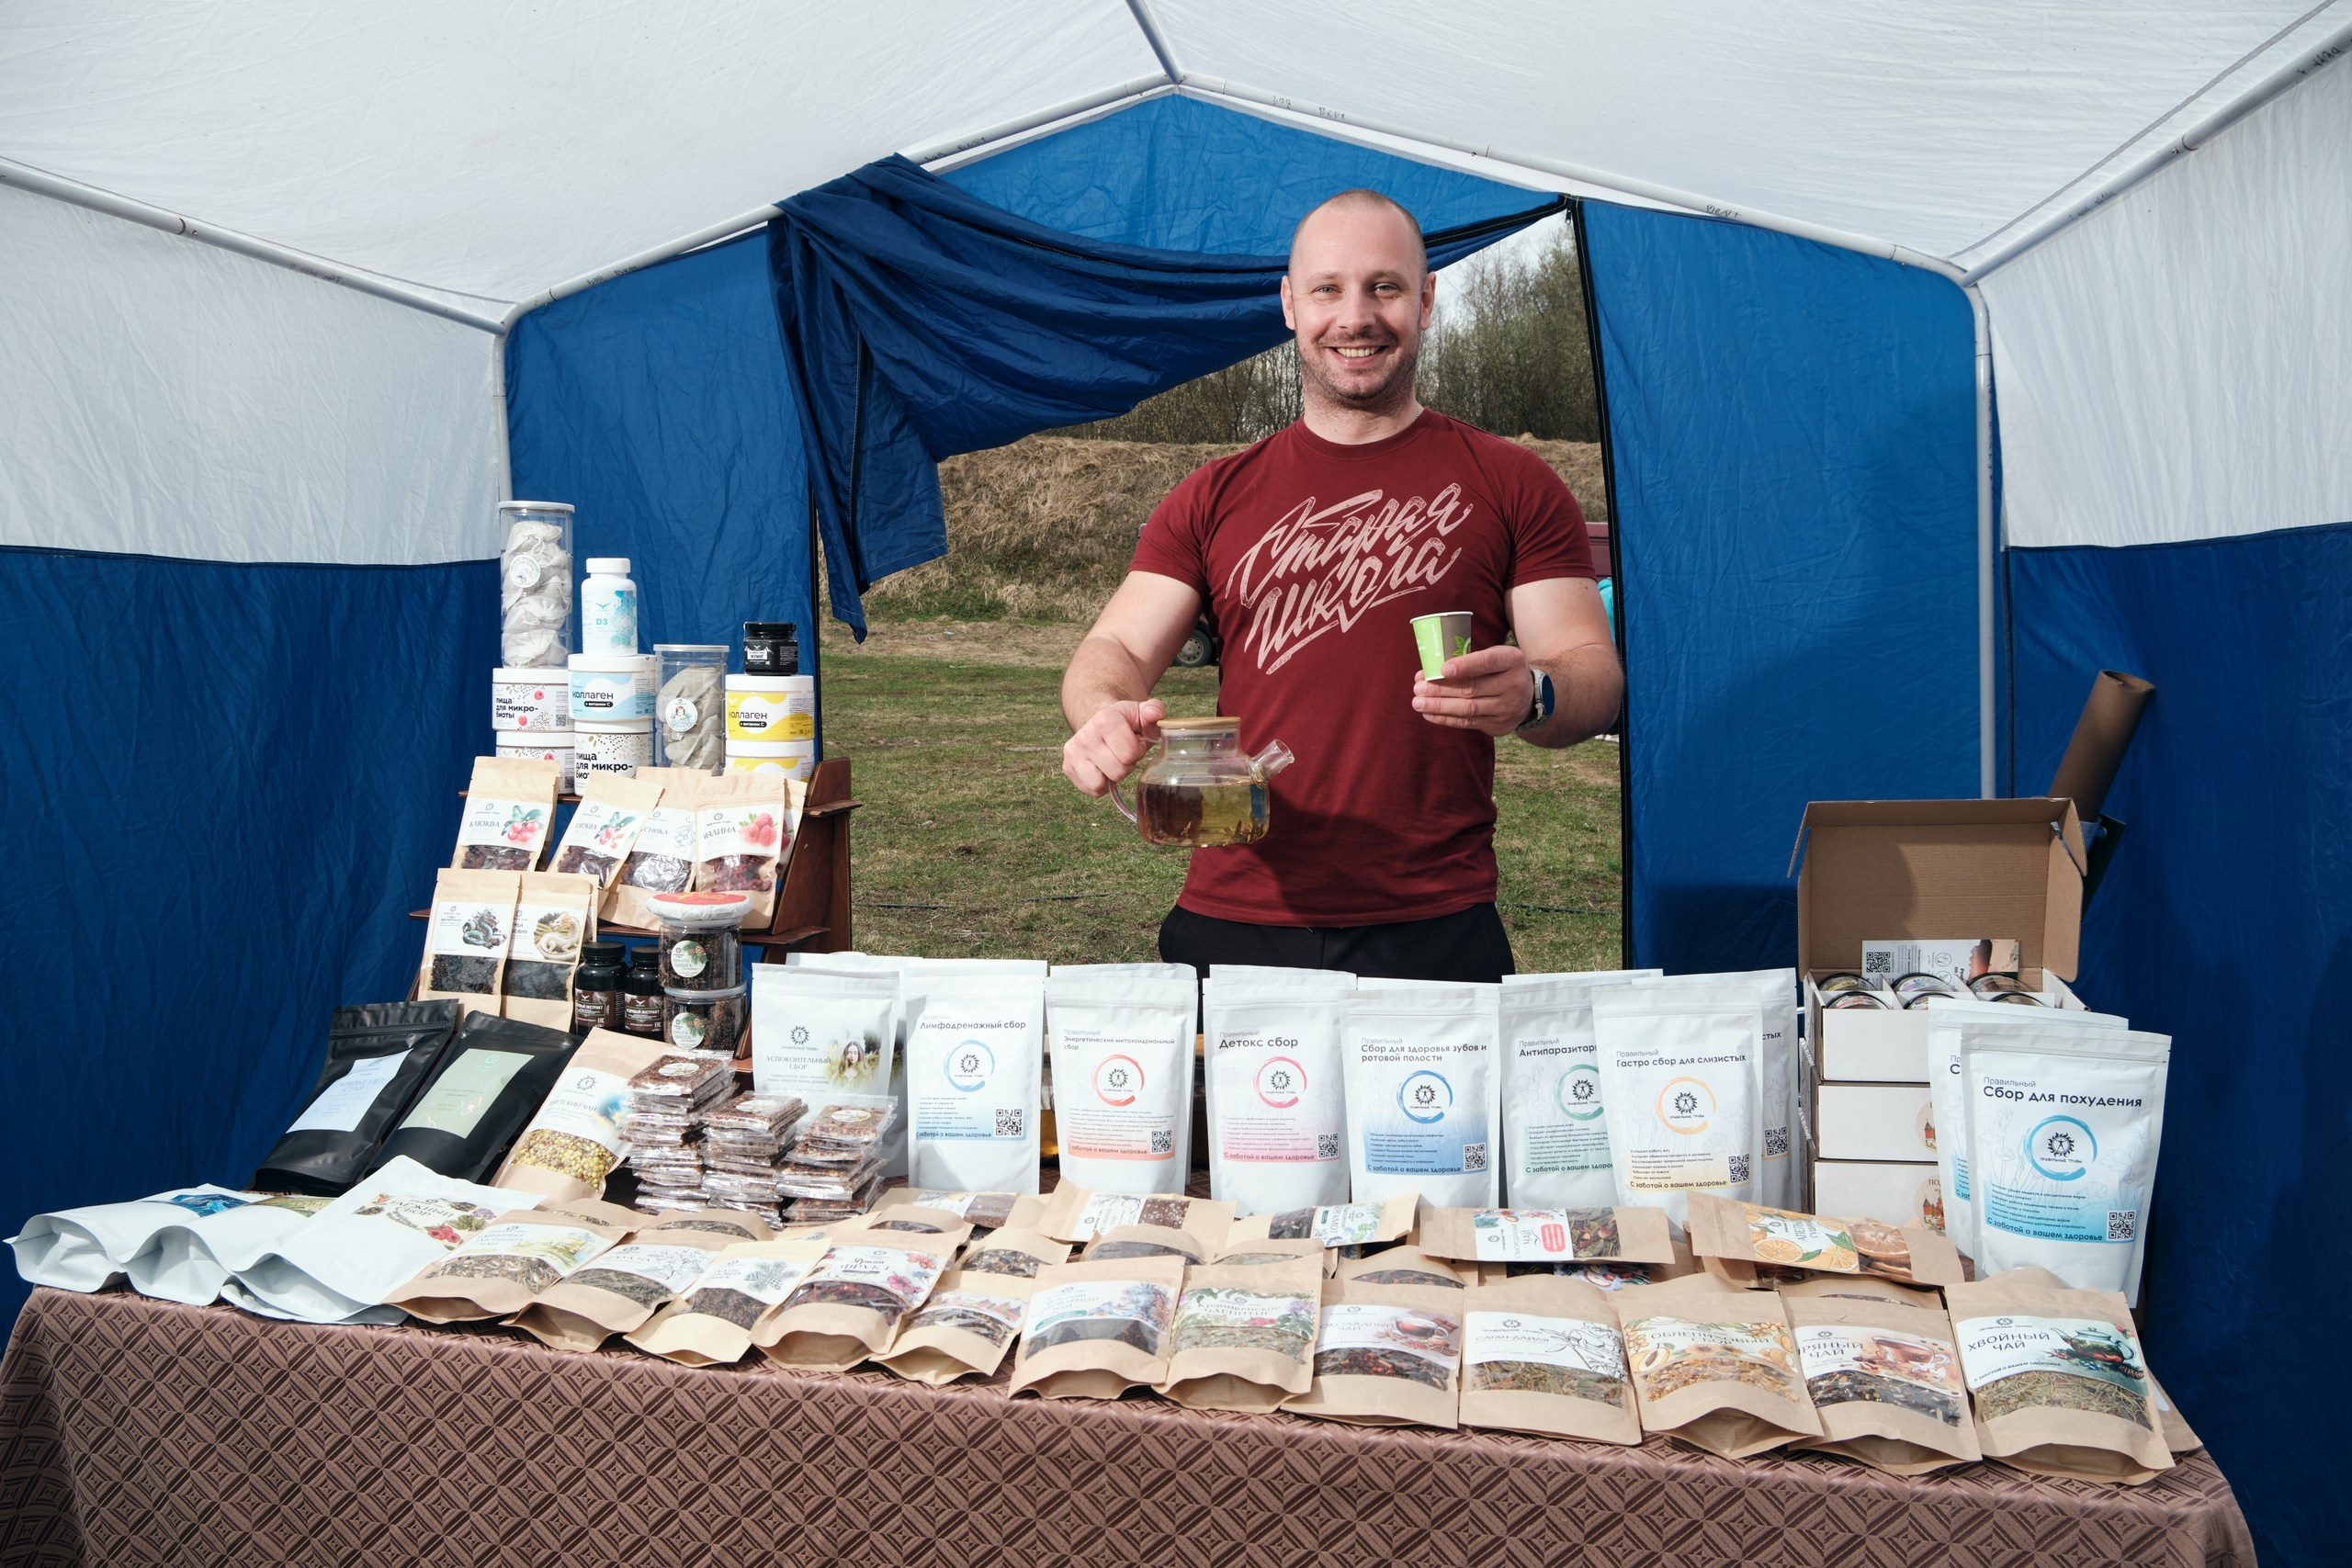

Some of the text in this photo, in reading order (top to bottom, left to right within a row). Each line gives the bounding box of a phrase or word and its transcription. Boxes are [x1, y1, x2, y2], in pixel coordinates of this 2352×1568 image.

[496, 697, 513, 705] пища
[571, 691, 614, 700] коллаген
[508, 705, 538, 714] микро-
[576, 752, 597, 761] пища
[576, 761, 633, 773] для микро-
[576, 769, 590, 780] био
[920, 1021, 1026, 1030] Лимфодренажный сбор
[1219, 1037, 1298, 1049] Детокс сбор
[1361, 1044, 1386, 1054] Сбор
[1408, 1045, 1450, 1054] здоровья
[1453, 1043, 1479, 1054] зубов
[1519, 1044, 1597, 1057] Антипаразитар
[1362, 1054, 1401, 1063] ротовой
[1616, 1055, 1747, 1068] Гастро сбор для слизистых
[1984, 1077, 2036, 1088] Правильный
[1983, 1085, 2143, 1108] Сбор для похудения
[1994, 1220, 2024, 1234] заботой
[2032, 1230, 2063, 1238] вашем
[2064, 1233, 2103, 1242] здоровье
[1320, 1321, 1396, 1329] ОКОЛАДНЫЙ
[1968, 1331, 2051, 1352] ХВОЙНЫЙ
[1993, 1339, 2026, 1351] ЧАЙ
[1809, 1348, 1844, 1359] ЧАЙ
